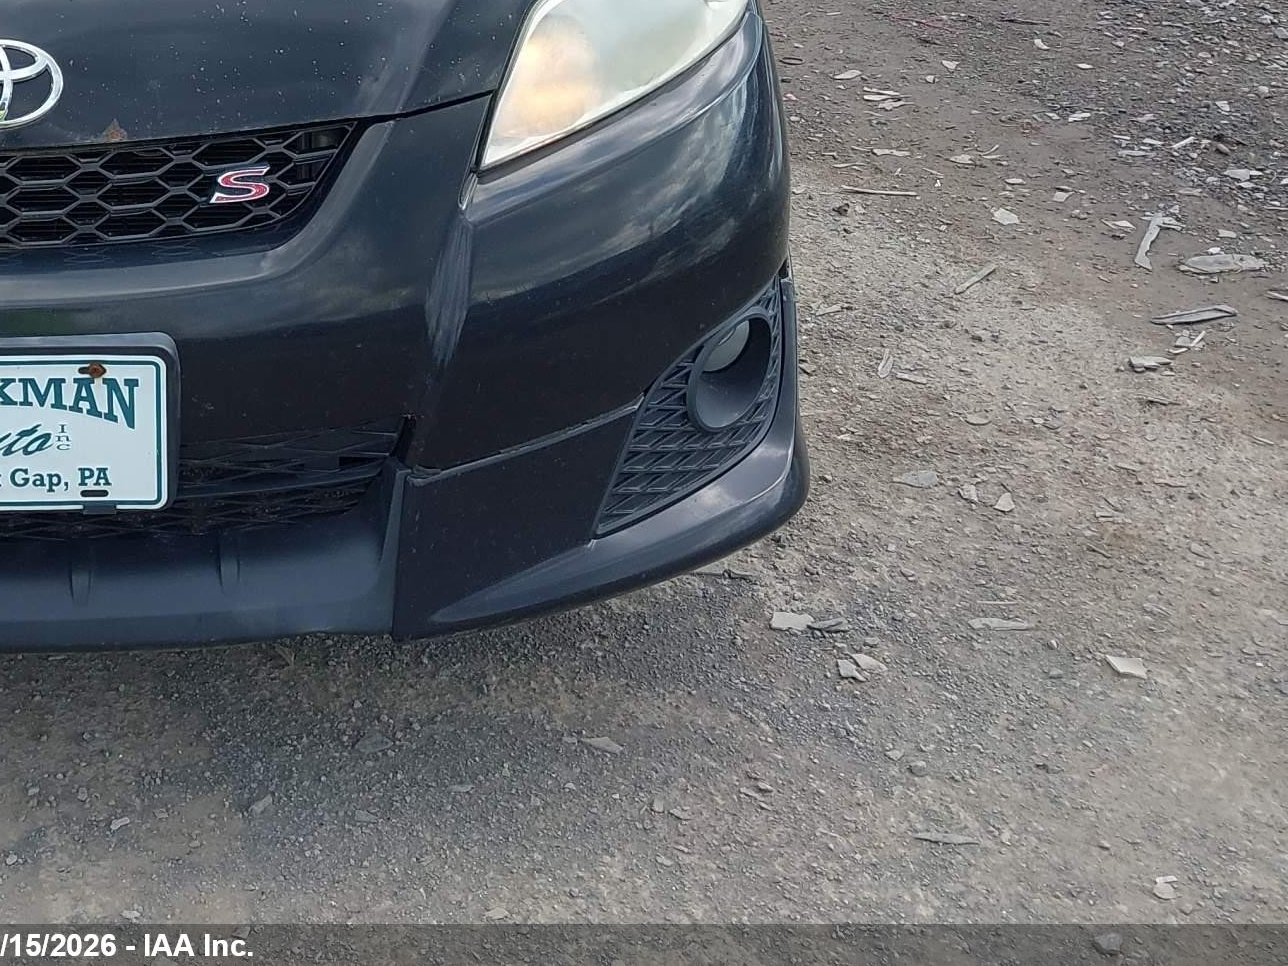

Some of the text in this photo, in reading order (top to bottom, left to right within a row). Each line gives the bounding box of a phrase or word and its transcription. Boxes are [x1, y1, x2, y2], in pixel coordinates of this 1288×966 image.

[209, 166, 270, 203] S
[9, 467, 69, 493] Gap,
[78, 467, 112, 487] PA
